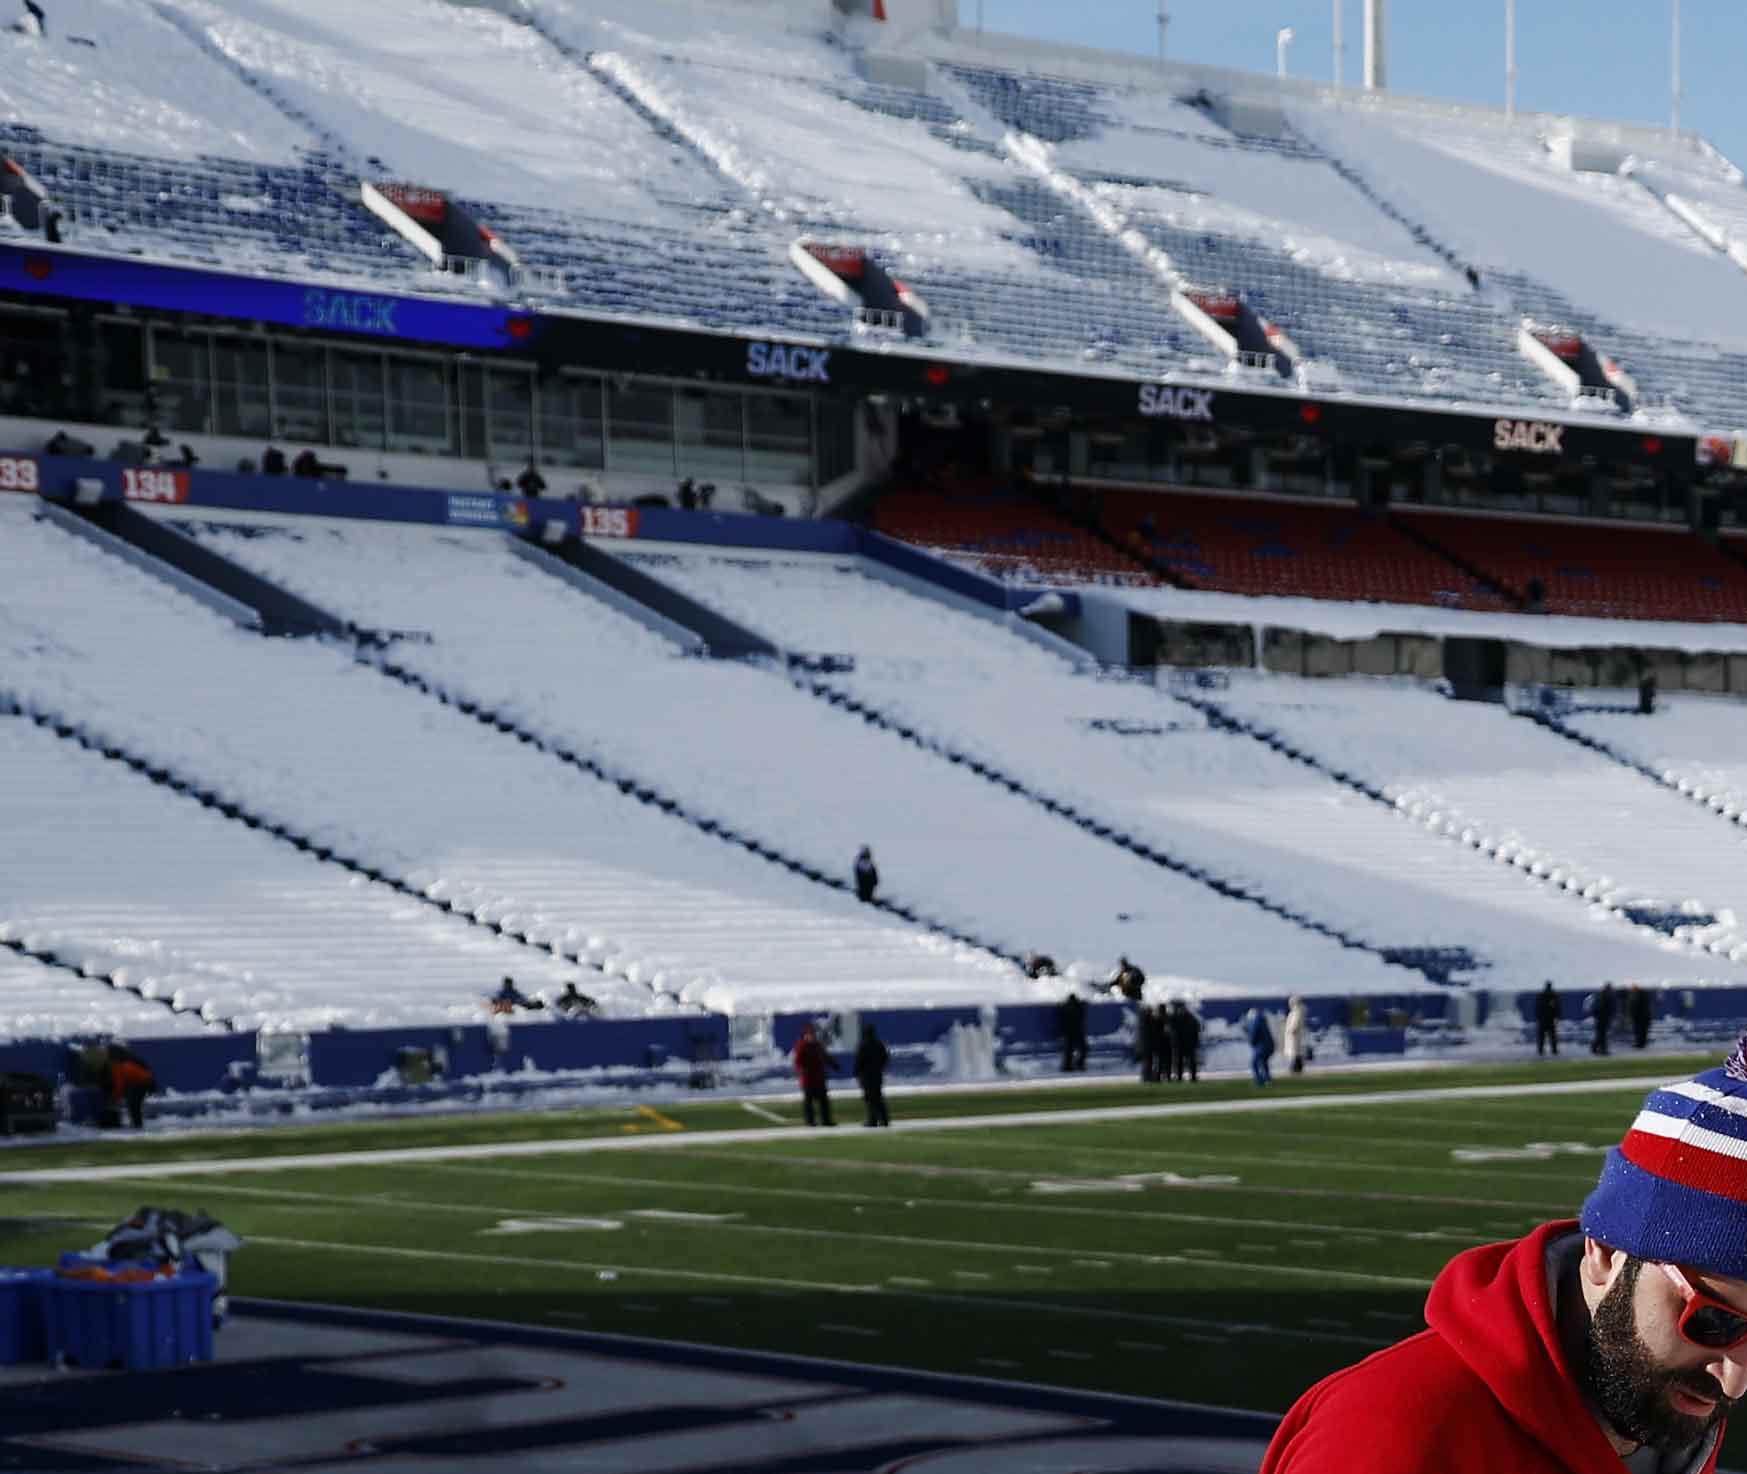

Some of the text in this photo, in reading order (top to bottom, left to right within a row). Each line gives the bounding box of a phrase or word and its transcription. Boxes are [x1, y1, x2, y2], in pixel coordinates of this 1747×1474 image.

[304, 289, 397, 333] SACK
[747, 342, 832, 382] SACK
[1138, 384, 1214, 422] SACK
[1493, 419, 1565, 455] SACK
[122, 468, 176, 502] 134
[580, 506, 628, 537] 135
